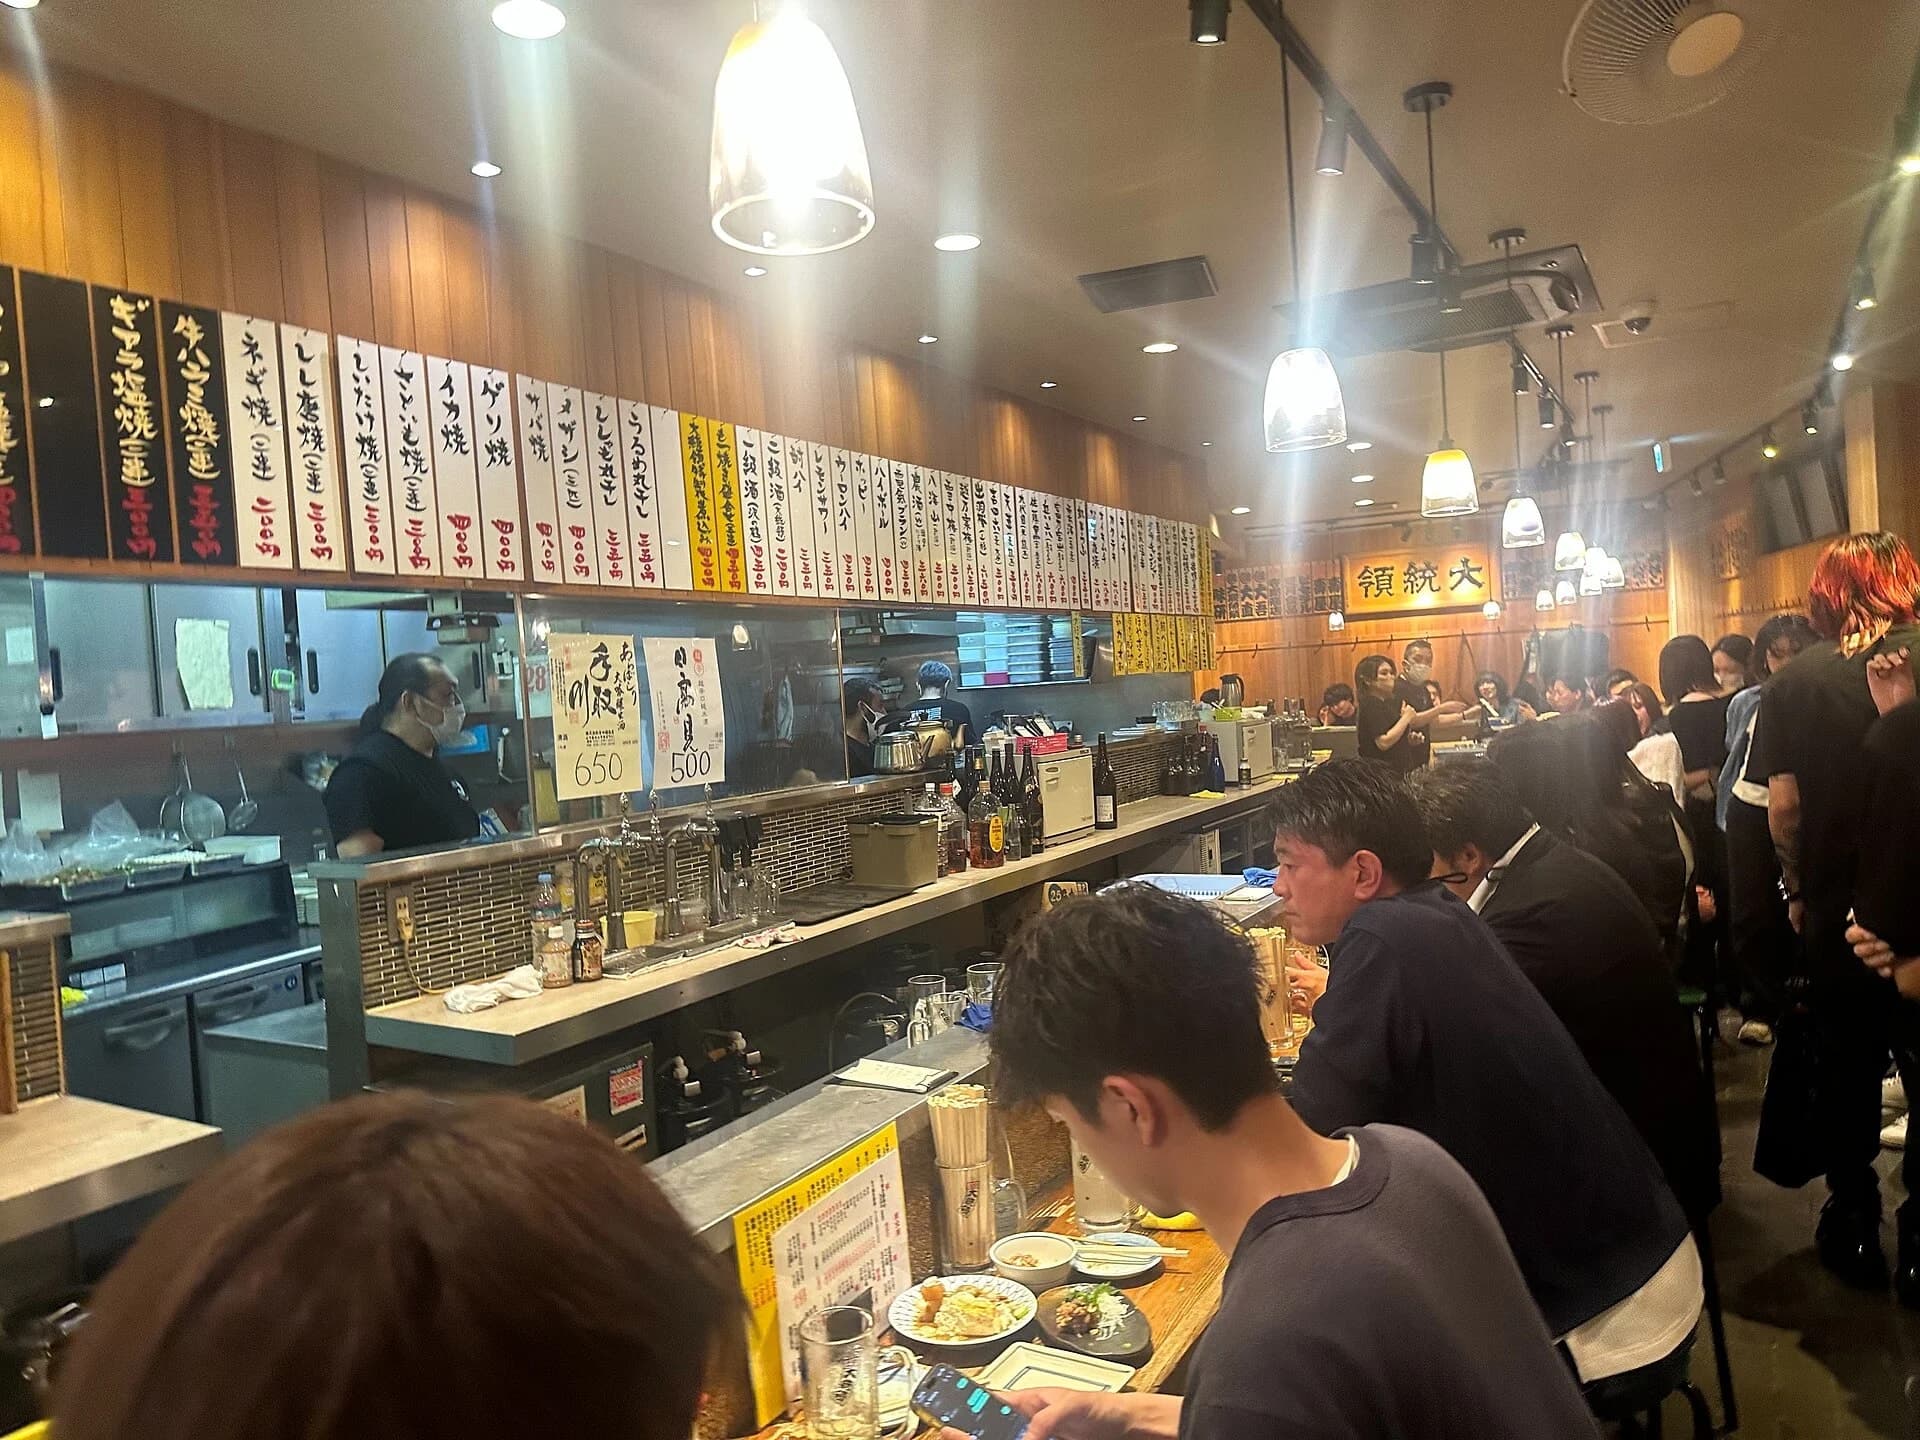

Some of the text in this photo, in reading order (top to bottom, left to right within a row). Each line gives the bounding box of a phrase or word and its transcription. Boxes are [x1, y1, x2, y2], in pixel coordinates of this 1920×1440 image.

[440, 376, 469, 455] イカ焼
[481, 379, 512, 468] ゲソ焼
[526, 392, 549, 463] サバ焼
[595, 406, 617, 506] ししゃも丸干し
[629, 412, 649, 518] うるめ丸干し
[814, 450, 829, 535] レモンサワー
[835, 455, 851, 531] ウーロンハイ
[855, 456, 868, 514] ホッピー
[875, 467, 888, 529] ハイボール
[575, 751, 623, 787] 650
[670, 749, 711, 784] 500
